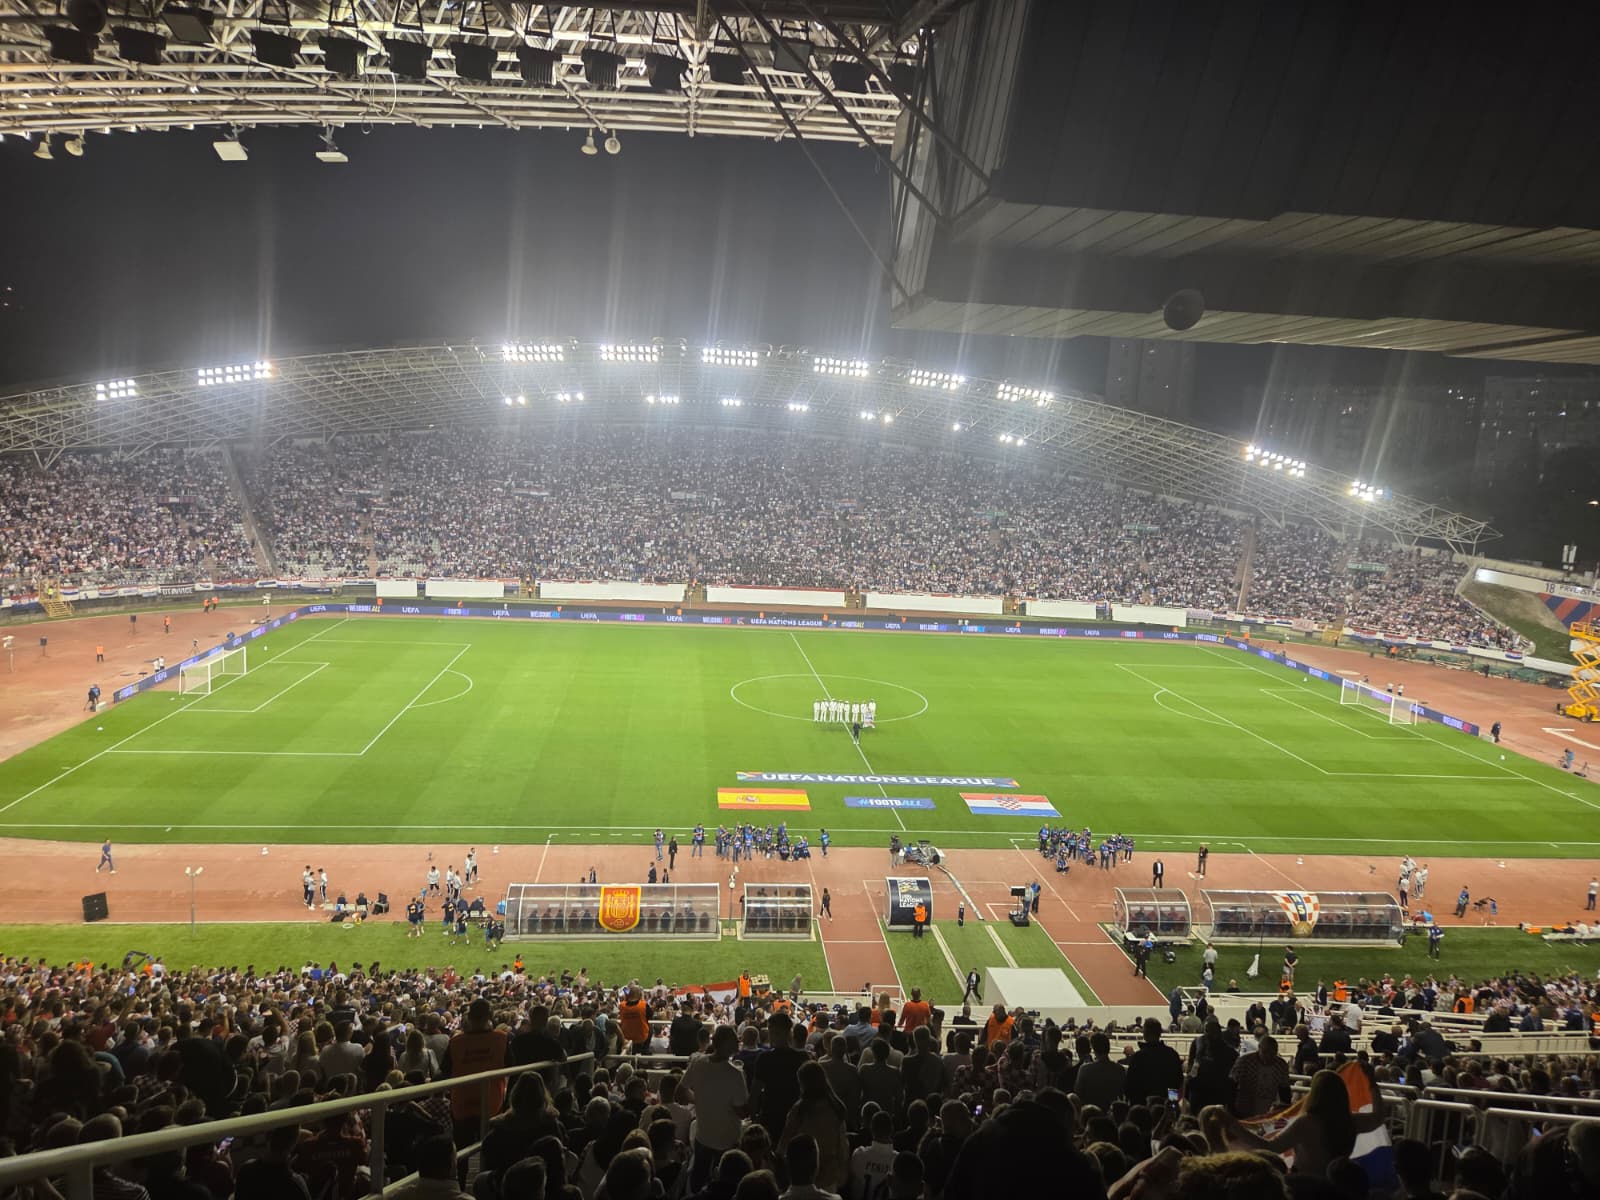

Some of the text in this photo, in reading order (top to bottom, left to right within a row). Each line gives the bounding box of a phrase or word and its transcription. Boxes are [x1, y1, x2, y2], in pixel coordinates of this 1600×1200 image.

[762, 773, 996, 786] UEFA NATIONS LEAGUE
[857, 798, 921, 807] #FOOTBALL
